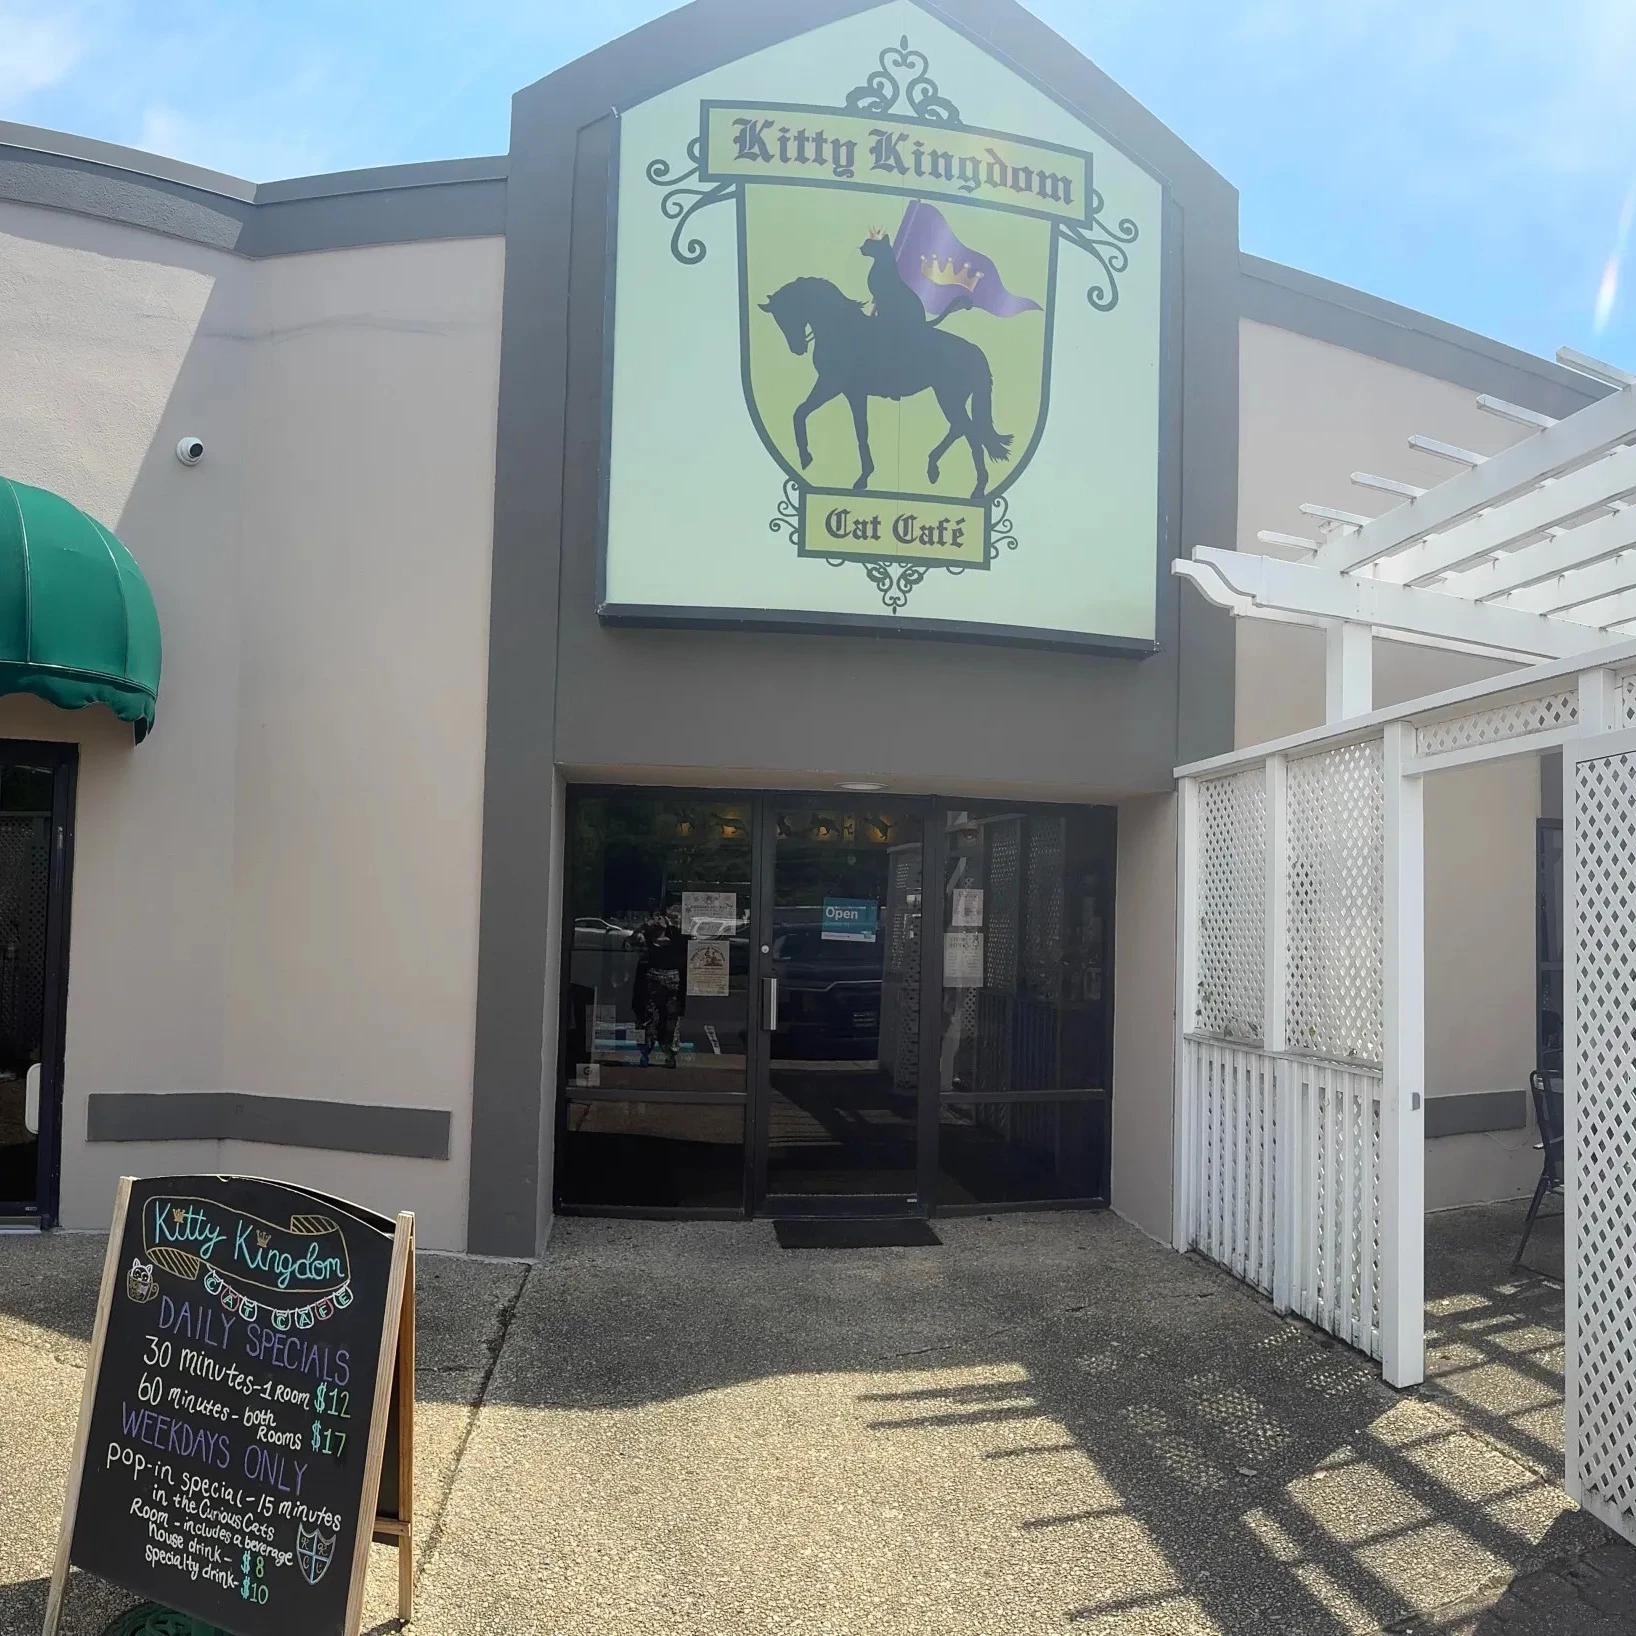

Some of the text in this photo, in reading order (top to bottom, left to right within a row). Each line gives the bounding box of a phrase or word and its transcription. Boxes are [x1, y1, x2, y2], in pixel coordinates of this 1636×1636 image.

[732, 118, 1075, 206] Kitty Kingdom
[824, 507, 967, 549] Cat Café
[826, 907, 858, 920] Open
[155, 1201, 345, 1288] Kitty Kingdom
[158, 1295, 350, 1385] DAILY SPECIALS
[138, 1372, 163, 1405] 60
[243, 1406, 276, 1427] both
[143, 1335, 172, 1367] 30
[314, 1382, 351, 1418] $12
[122, 1401, 308, 1496] WEEKDAYS ONLY
[312, 1420, 346, 1458] $17
[130, 1498, 168, 1527] Room
[184, 1517, 231, 1544] includes
[233, 1535, 241, 1545] a
[245, 1536, 293, 1567] beverage
[149, 1521, 184, 1549] house
[152, 1484, 275, 1541] in the Curious Cats
[279, 1501, 342, 1531] minutes
[145, 1544, 200, 1581] specialty
[241, 1577, 269, 1605] $10
